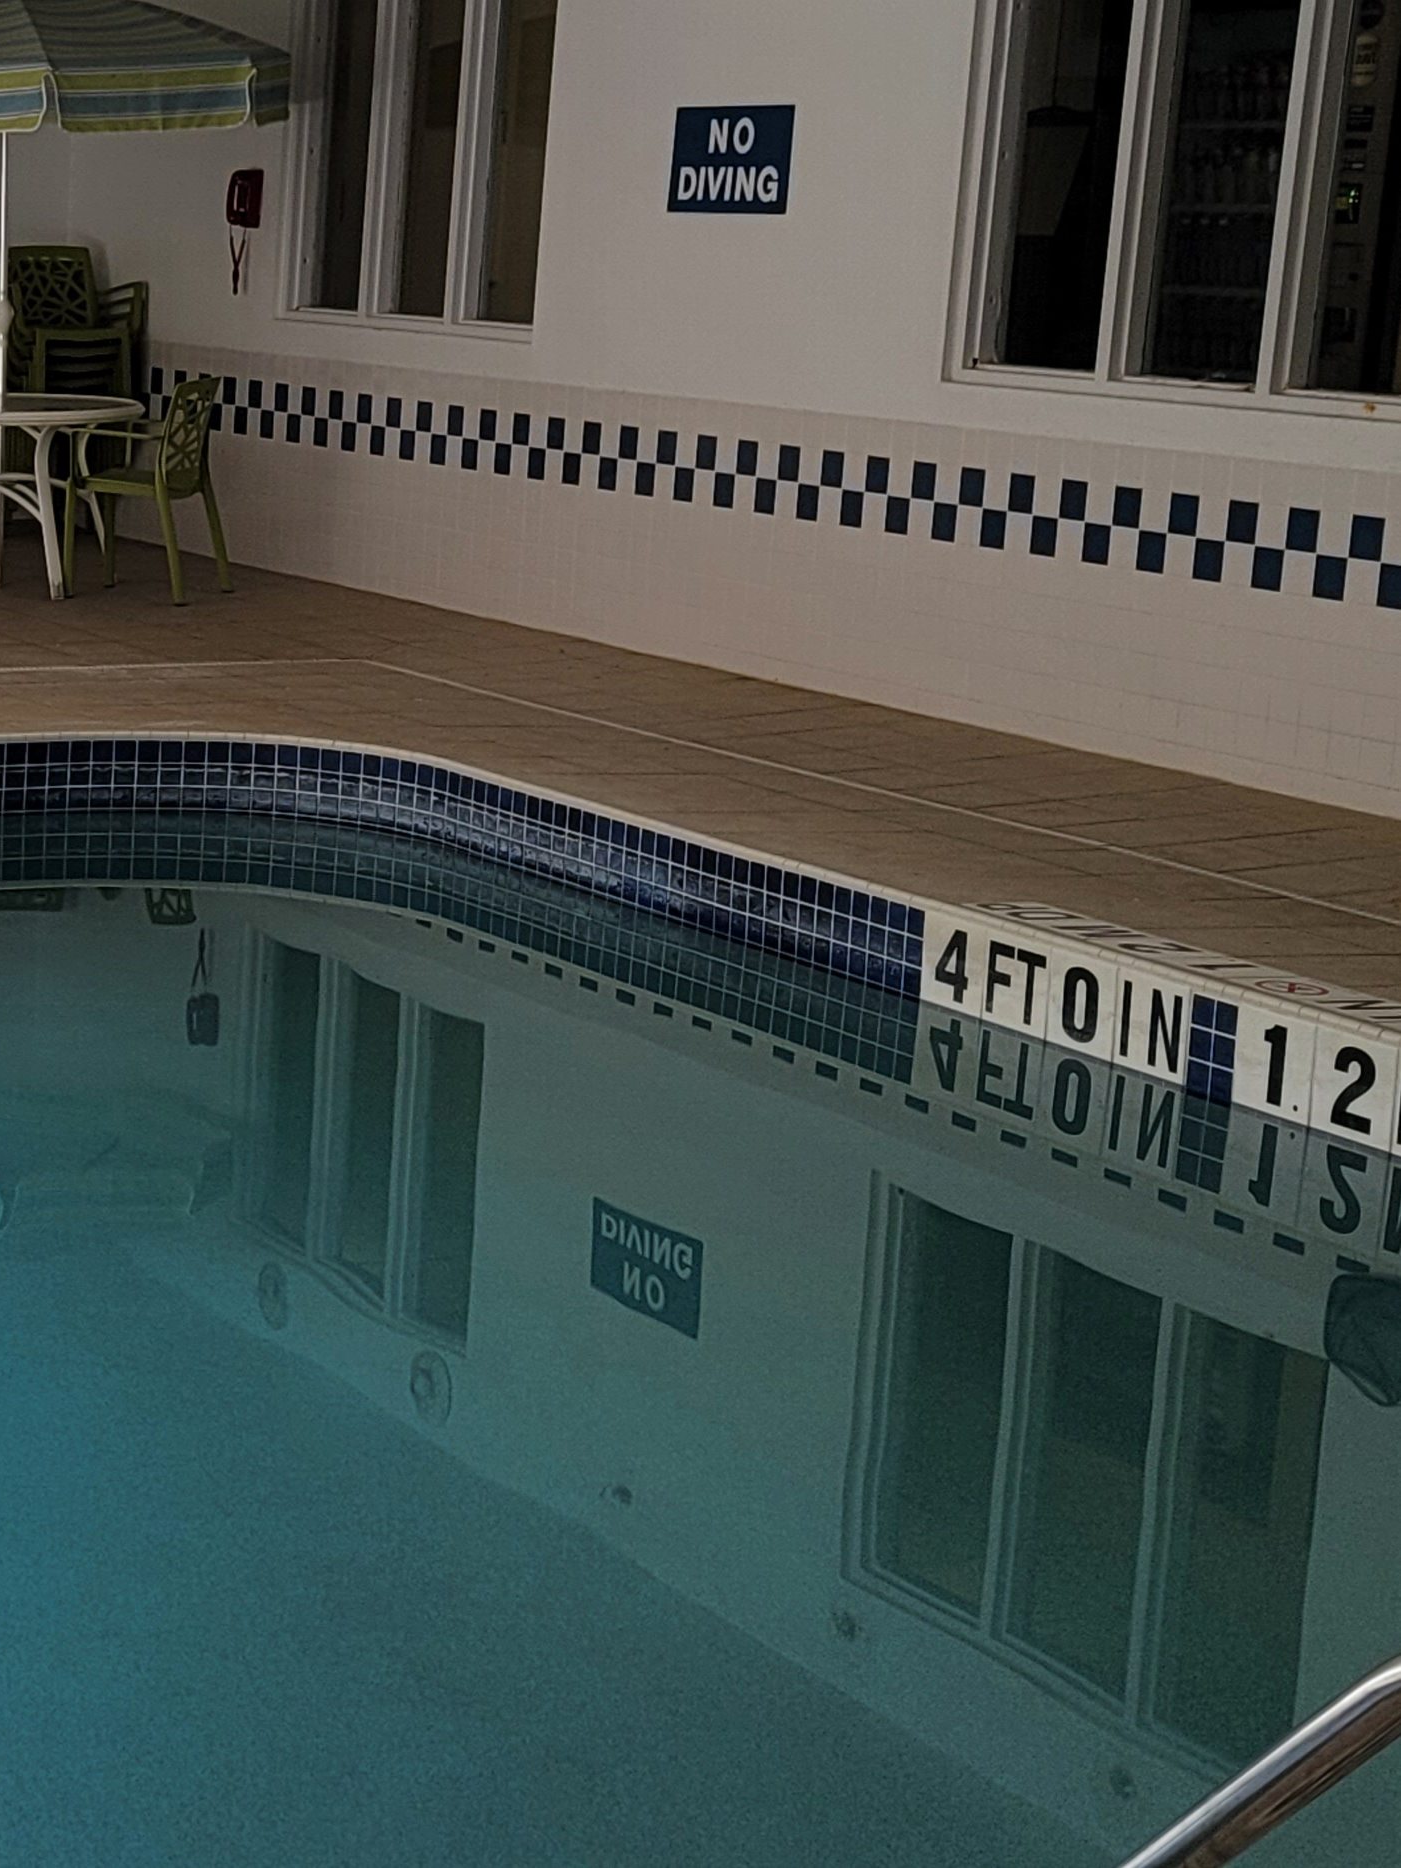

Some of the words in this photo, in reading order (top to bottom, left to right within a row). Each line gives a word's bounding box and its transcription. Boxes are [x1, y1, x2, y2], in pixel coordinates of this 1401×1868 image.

[707, 116, 756, 155] NO
[677, 165, 780, 203] DIVING
[935, 929, 968, 1004] 4
[985, 940, 1047, 1025] FT
[1119, 980, 1183, 1074] IN
